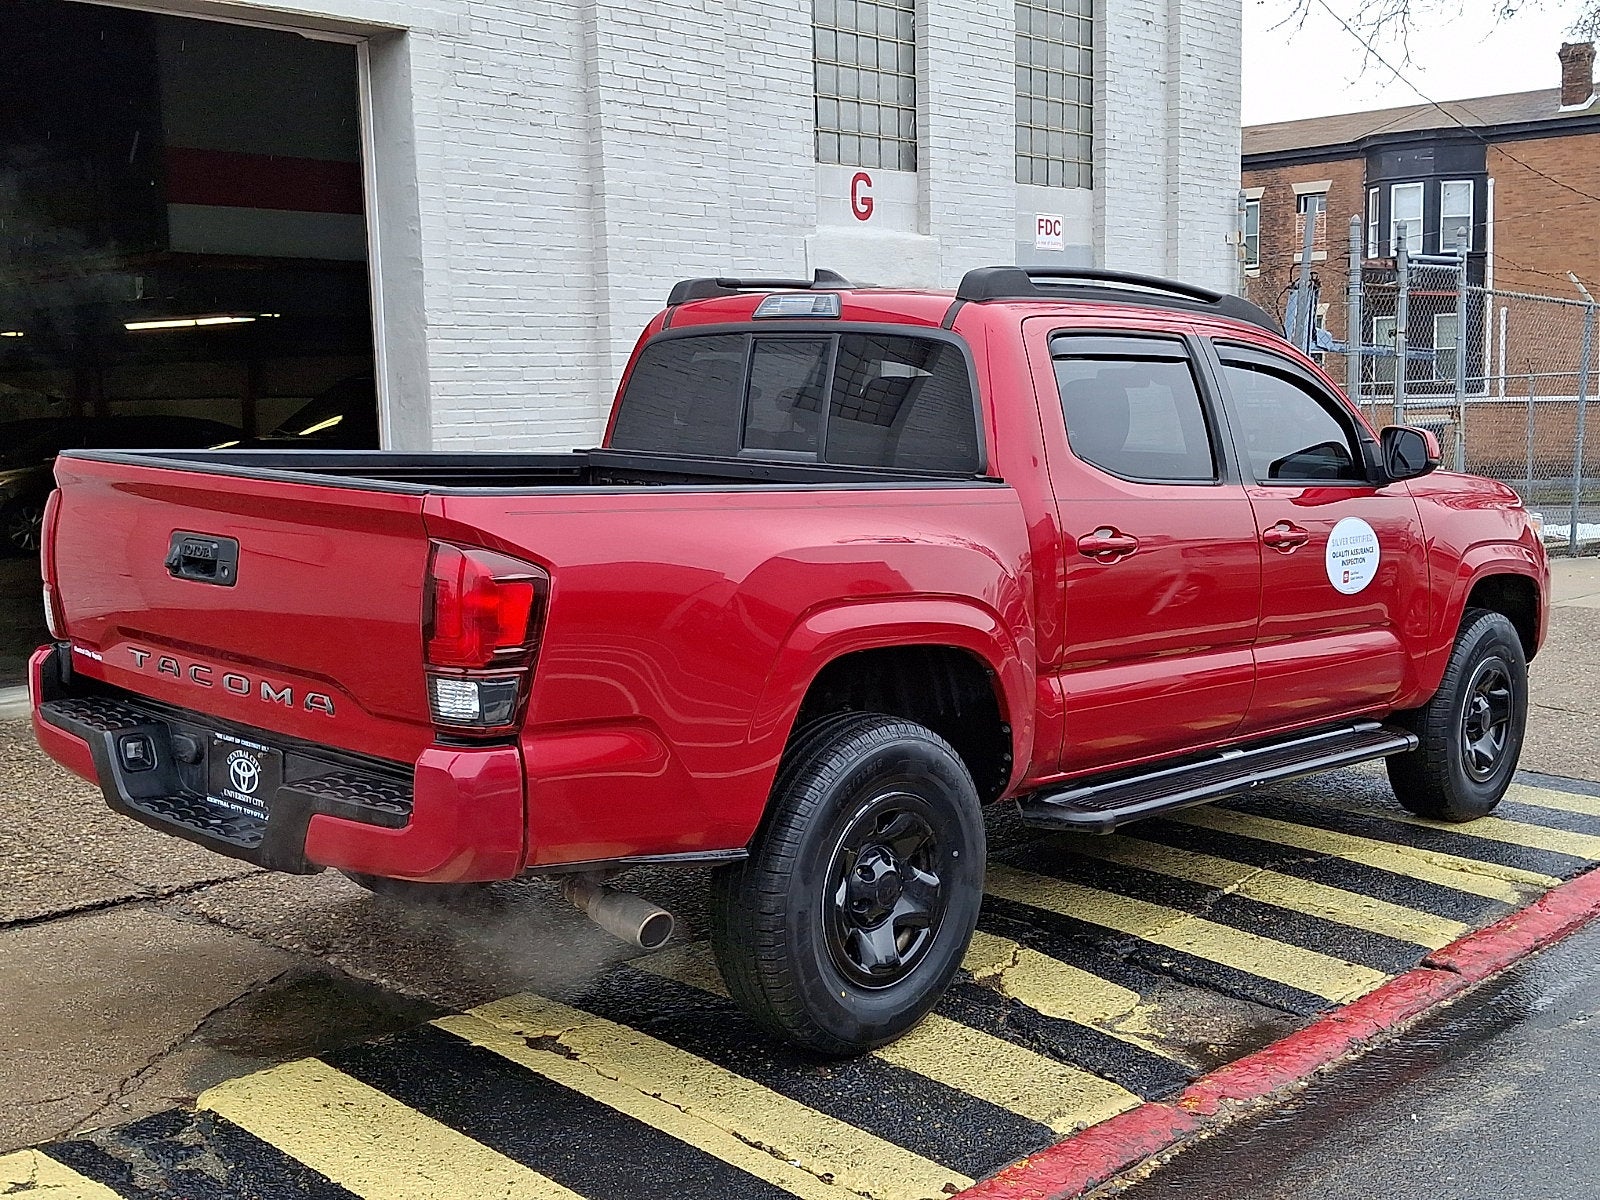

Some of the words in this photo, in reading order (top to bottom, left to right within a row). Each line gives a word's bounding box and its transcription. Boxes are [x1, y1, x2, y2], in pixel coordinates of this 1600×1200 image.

[851, 172, 874, 221] G
[1038, 218, 1061, 236] FDC
[1331, 549, 1350, 559] QUALITY
[1350, 546, 1374, 556] ASSURANCE
[1341, 557, 1366, 566] INSPECTION
[126, 646, 336, 716] TACOMA
[226, 749, 249, 765] CENTRAL
[249, 754, 262, 772] CITY
[206, 796, 230, 808] CENTRAL
[230, 803, 243, 812] CITY
[243, 807, 265, 820] TOYOTA
[223, 788, 253, 804] UNIVERSITY
[252, 797, 265, 808] CITY
